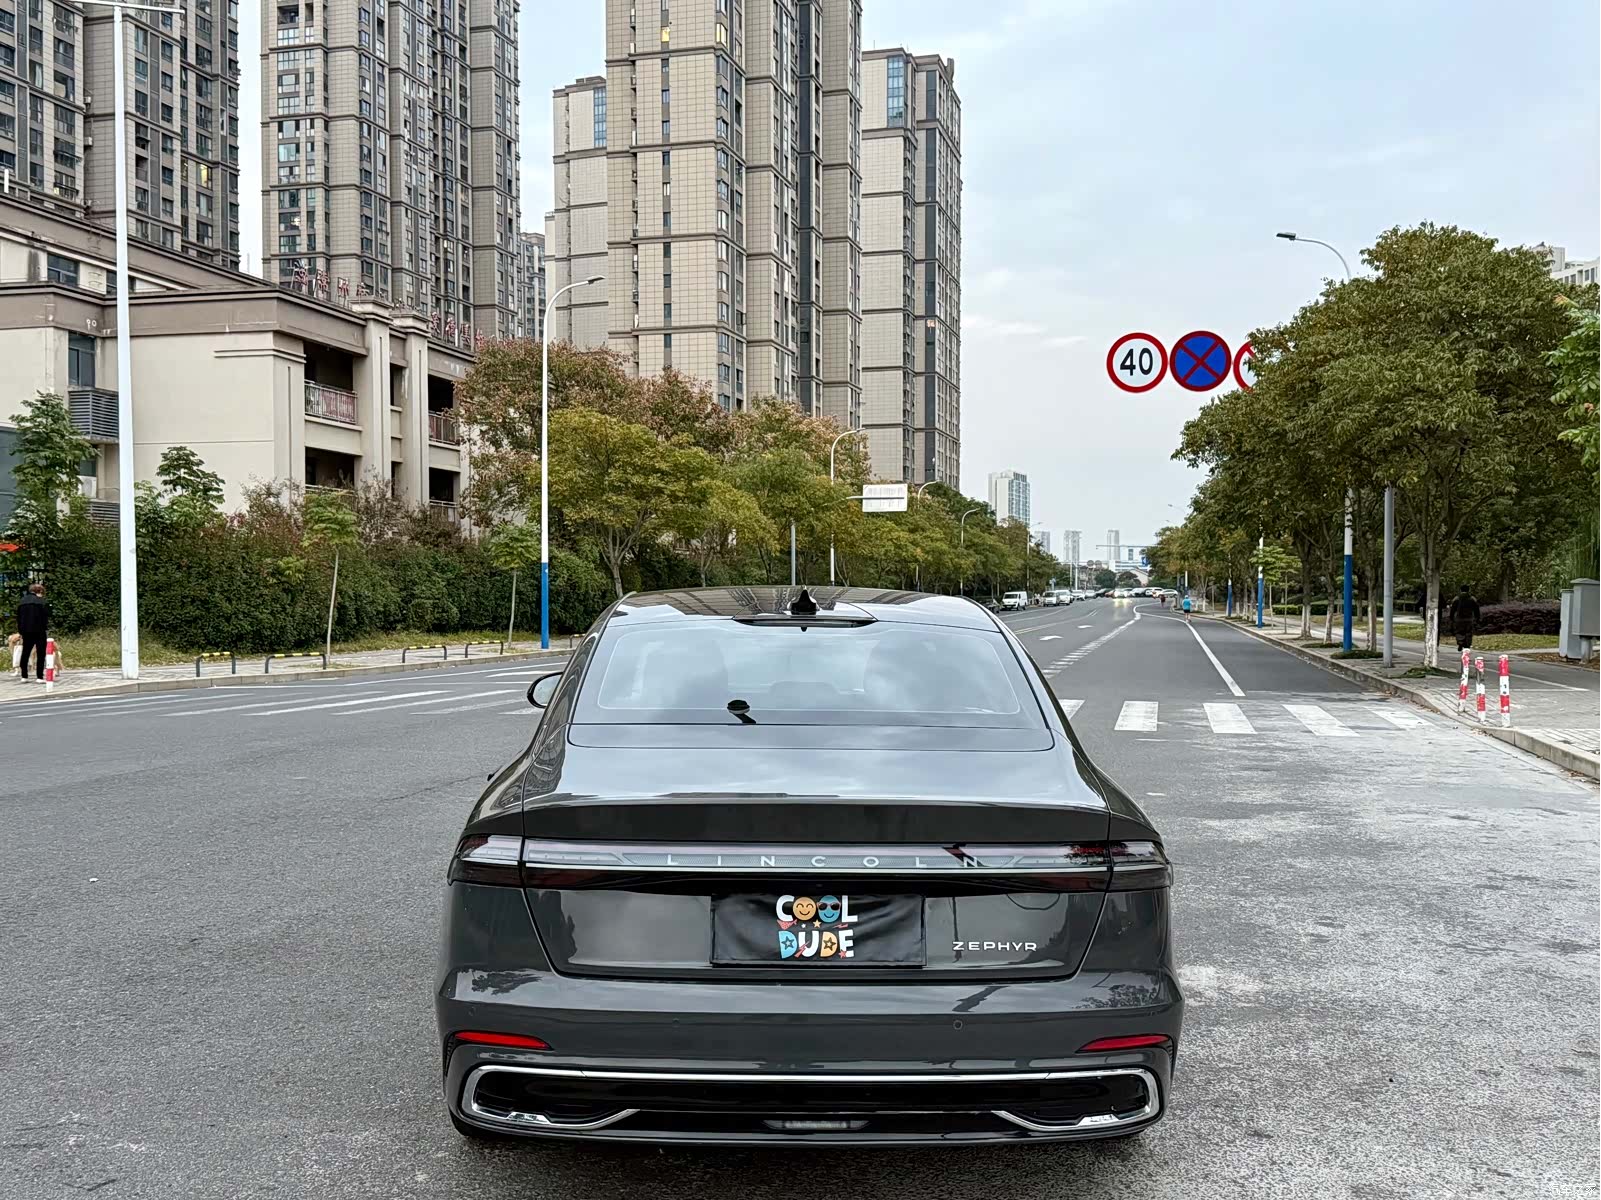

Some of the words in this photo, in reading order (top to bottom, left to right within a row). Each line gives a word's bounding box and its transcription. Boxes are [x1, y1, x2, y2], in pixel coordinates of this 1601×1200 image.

[1119, 347, 1154, 376] 40
[666, 854, 978, 868] LINCOLN
[775, 894, 859, 923] COOL
[777, 929, 855, 960] DUDE
[952, 940, 1038, 952] ZEPHYR
